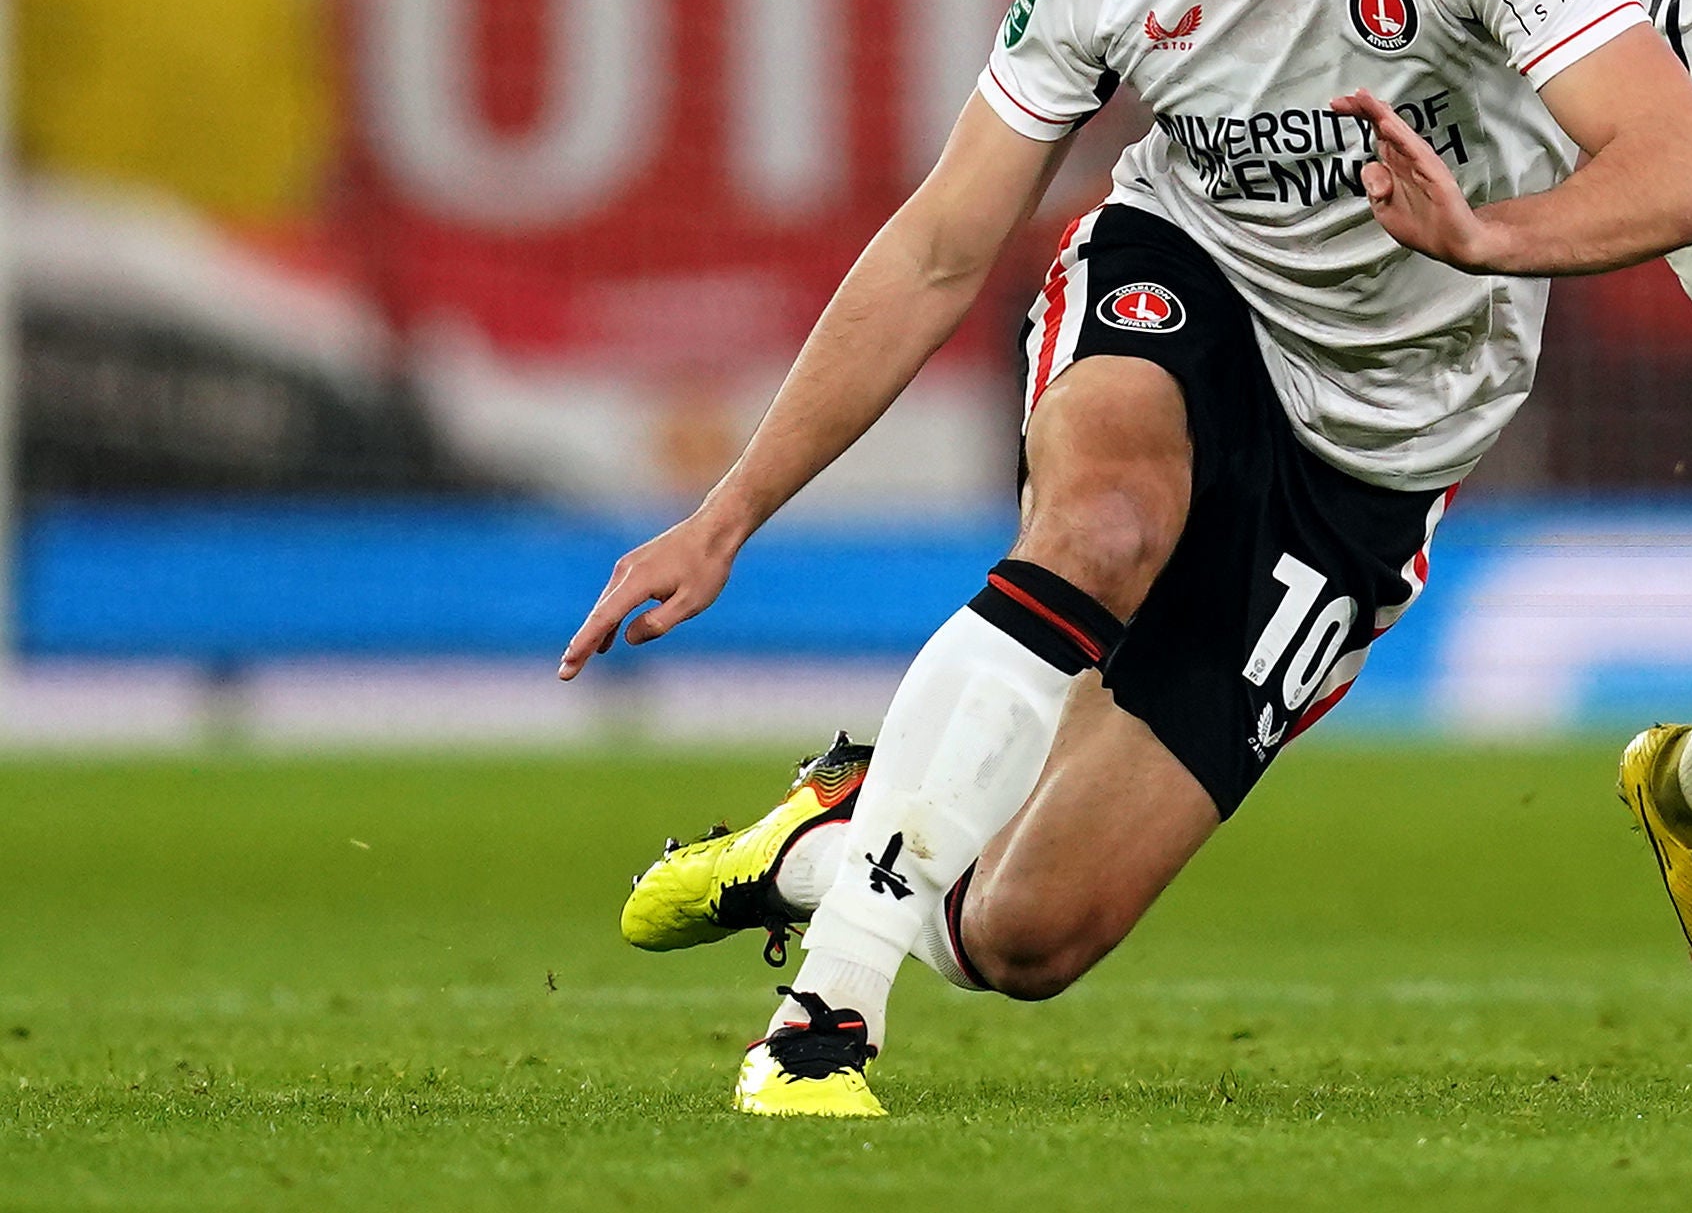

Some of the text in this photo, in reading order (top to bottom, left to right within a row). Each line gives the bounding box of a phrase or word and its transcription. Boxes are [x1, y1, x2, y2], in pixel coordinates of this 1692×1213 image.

[1366, 34, 1408, 49] ATHLETIC
[1393, 90, 1449, 134] OF
[1115, 285, 1172, 300] CHARLTON
[1116, 318, 1163, 329] ATHLETIC
[1241, 552, 1359, 711] 10
